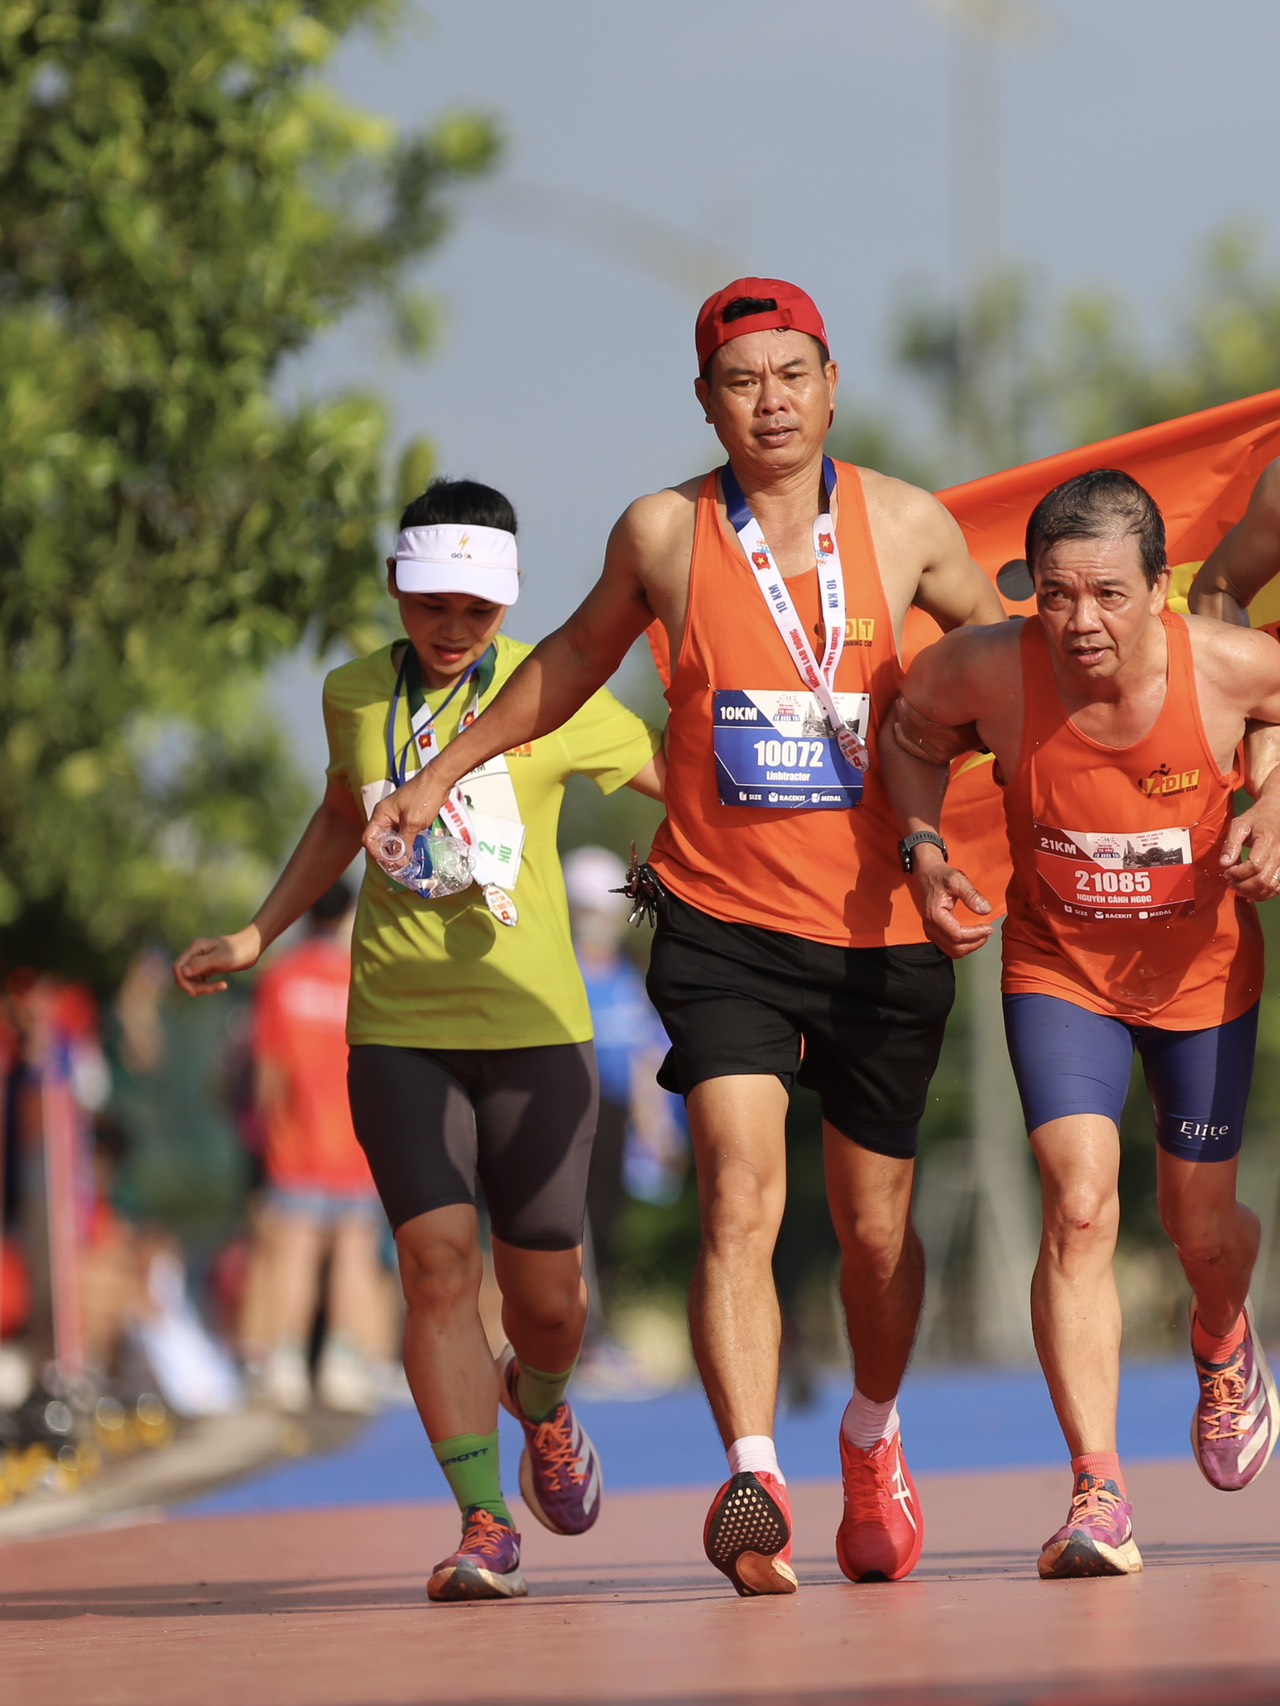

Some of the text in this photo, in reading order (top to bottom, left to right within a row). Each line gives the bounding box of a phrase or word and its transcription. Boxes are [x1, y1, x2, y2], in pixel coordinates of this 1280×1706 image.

[768, 583, 788, 615] 10 KM
[826, 578, 839, 609] 10 KM
[719, 706, 758, 721] 10KM
[753, 740, 824, 768] 10072
[766, 770, 811, 782] Linhtractor
[748, 793, 842, 802] SIZE RACEKIT MEDAL
[1162, 787, 1185, 798] RUNNING
[478, 840, 496, 856] 2
[1040, 837, 1077, 855] 21KM
[1074, 870, 1151, 893] 21085
[1074, 909, 1088, 917] SIZE
[1149, 909, 1172, 918] MEDAL
[1180, 1121, 1229, 1137] Elite
